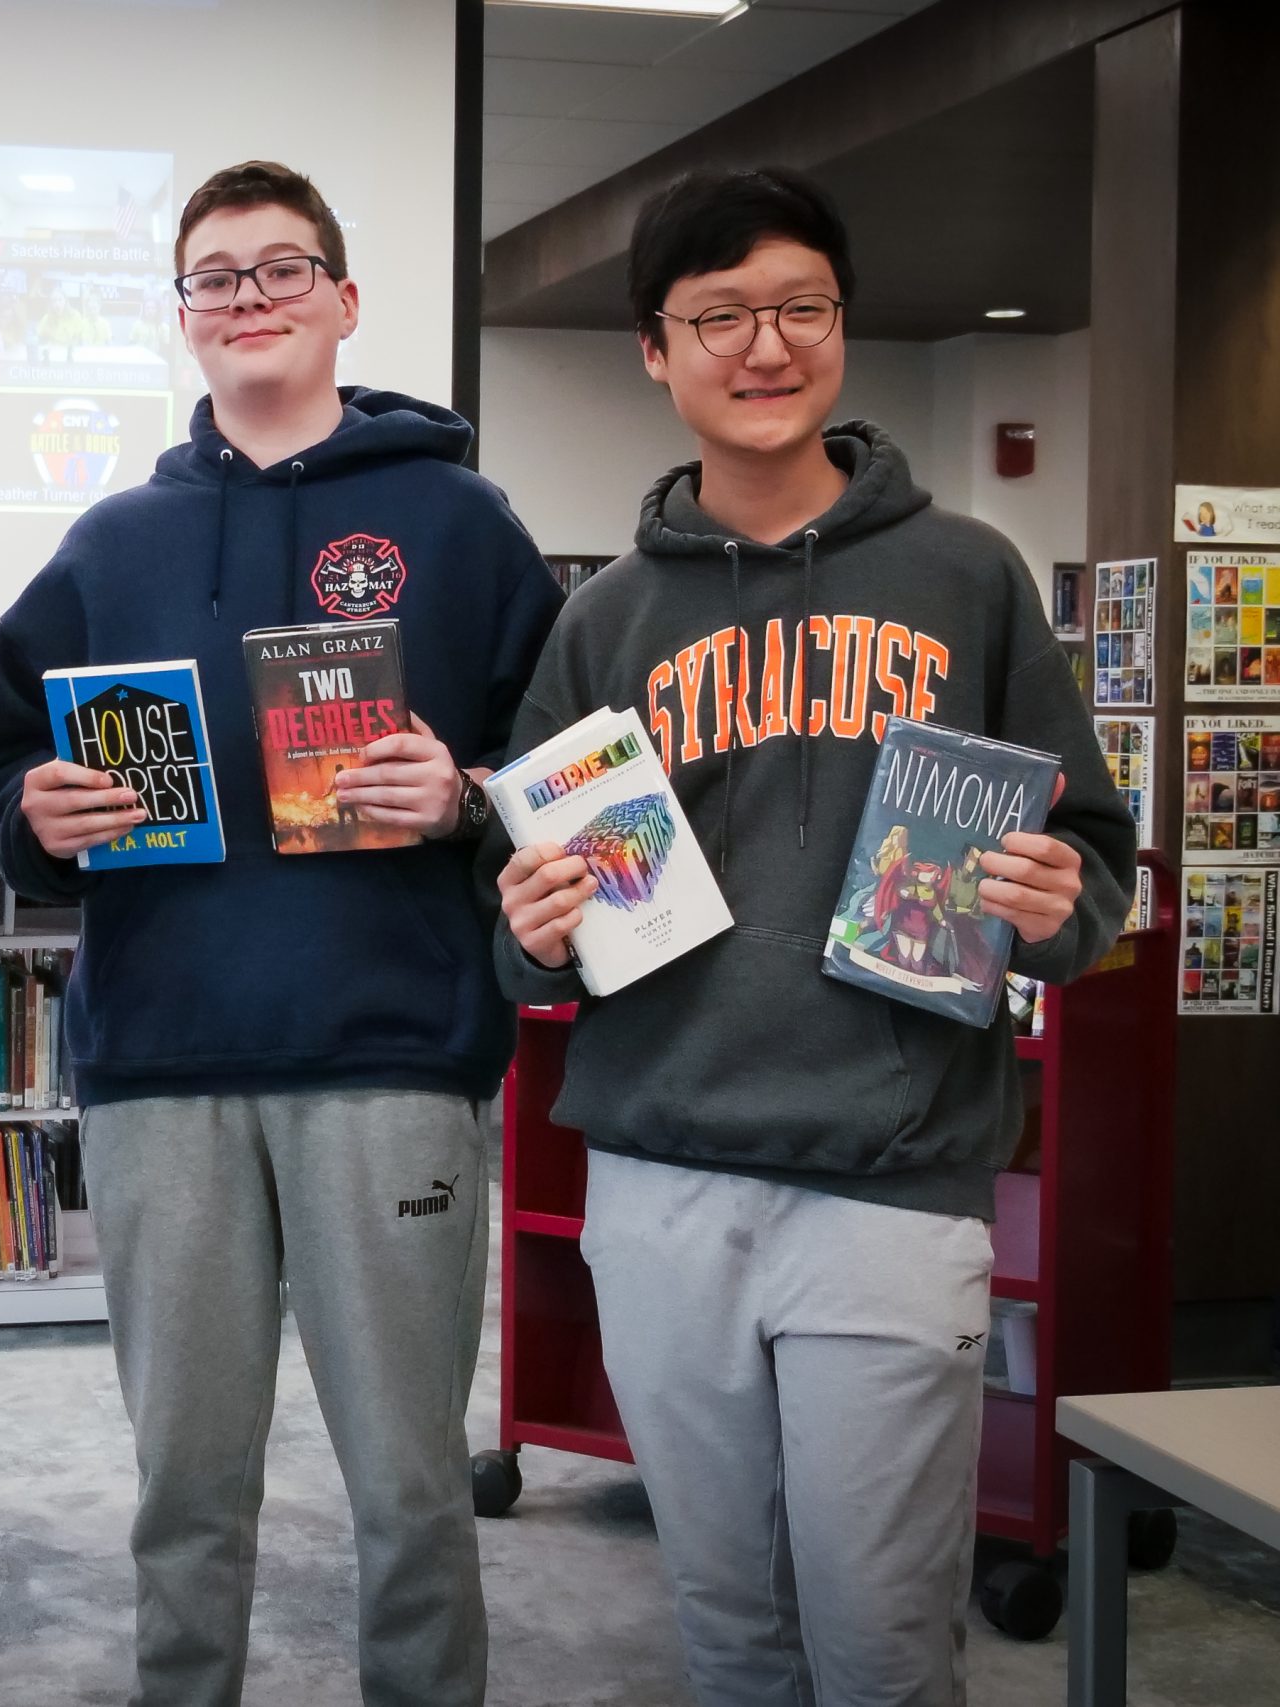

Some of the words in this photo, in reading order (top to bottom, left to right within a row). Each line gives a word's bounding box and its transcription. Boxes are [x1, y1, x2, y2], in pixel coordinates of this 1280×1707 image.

[10, 244, 60, 259] Sackets
[63, 246, 108, 260] Harbor
[113, 248, 150, 262] Battle
[63, 415, 90, 427] CNY
[30, 432, 70, 453] BATTLE
[43, 488, 85, 501] Turner
[1232, 502, 1263, 513] What
[1189, 556, 1199, 564] IF
[1202, 556, 1224, 564] YOU
[325, 583, 349, 592] HAZ
[368, 581, 394, 590] MAT
[261, 643, 311, 660] ALAN
[322, 635, 384, 654] GRATZ
[299, 667, 354, 703] TWO
[648, 615, 949, 774] SYRACUSE
[70, 689, 194, 767] HOUSE
[266, 699, 399, 750] DEGREES
[1186, 719, 1198, 728] IF
[1200, 719, 1222, 728] YOU
[524, 750, 609, 812] MARIE
[603, 731, 643, 768] LU
[104, 764, 206, 821] REST
[883, 749, 1024, 840] NIMONA
[111, 836, 140, 852] K.A.
[146, 831, 187, 848] HOLT
[1267, 873, 1277, 902] What
[634, 909, 672, 934] PLAYER
[1266, 904, 1277, 941] Should
[1264, 949, 1275, 976] Read
[398, 1194, 449, 1217] PUMA
